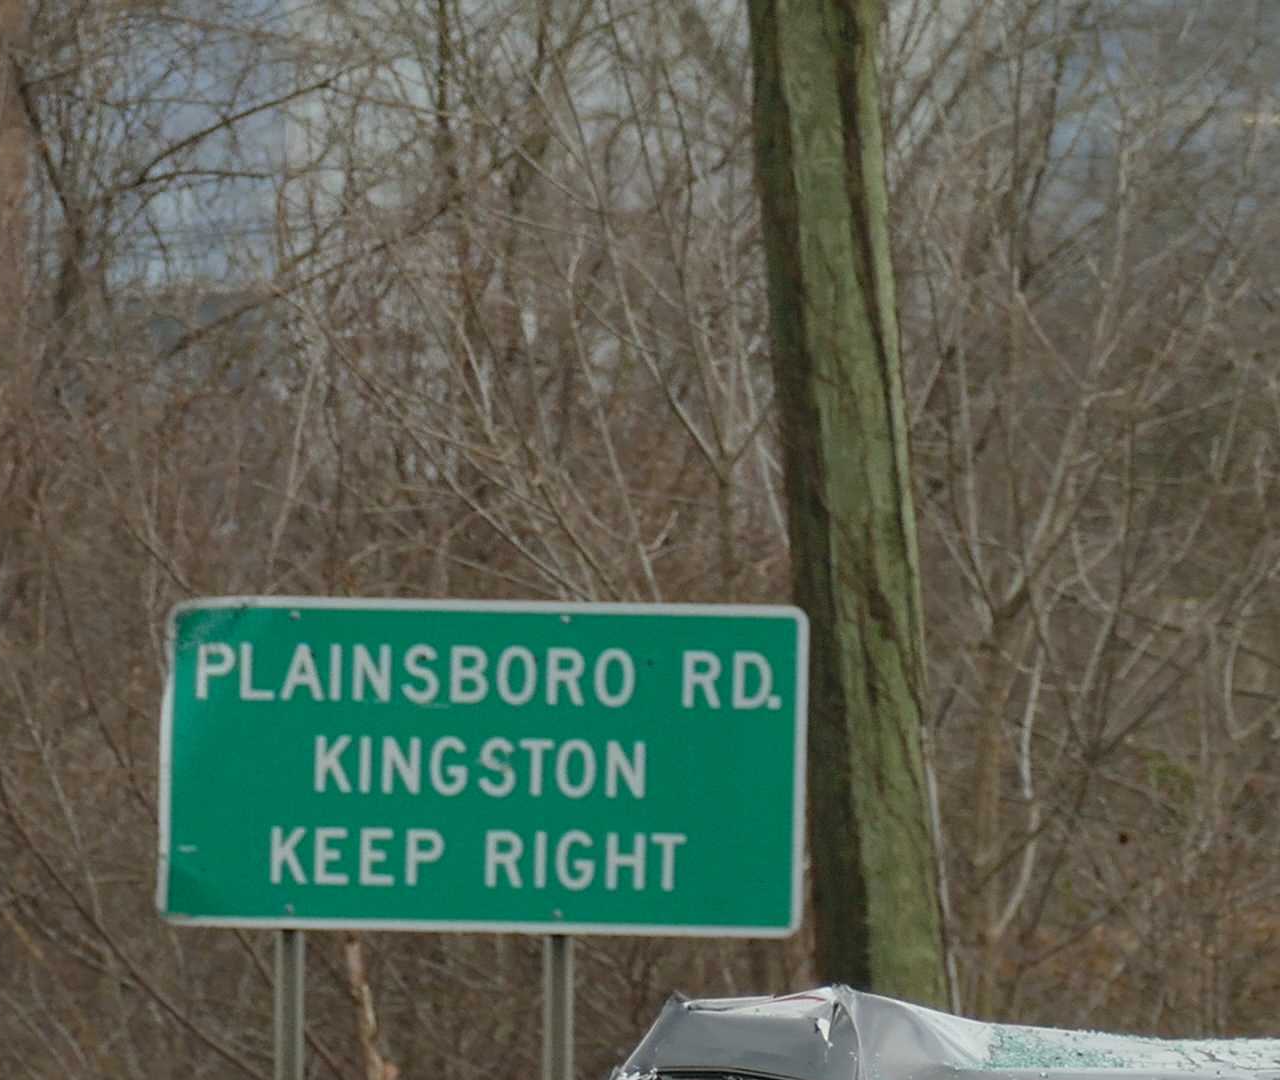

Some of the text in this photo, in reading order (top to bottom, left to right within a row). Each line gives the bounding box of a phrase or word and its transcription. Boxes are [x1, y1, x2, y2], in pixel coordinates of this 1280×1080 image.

[195, 642, 782, 710] PLAINSBORO RD.
[313, 735, 647, 799] KINGSTON
[269, 826, 687, 892] KEEP RIGHT
